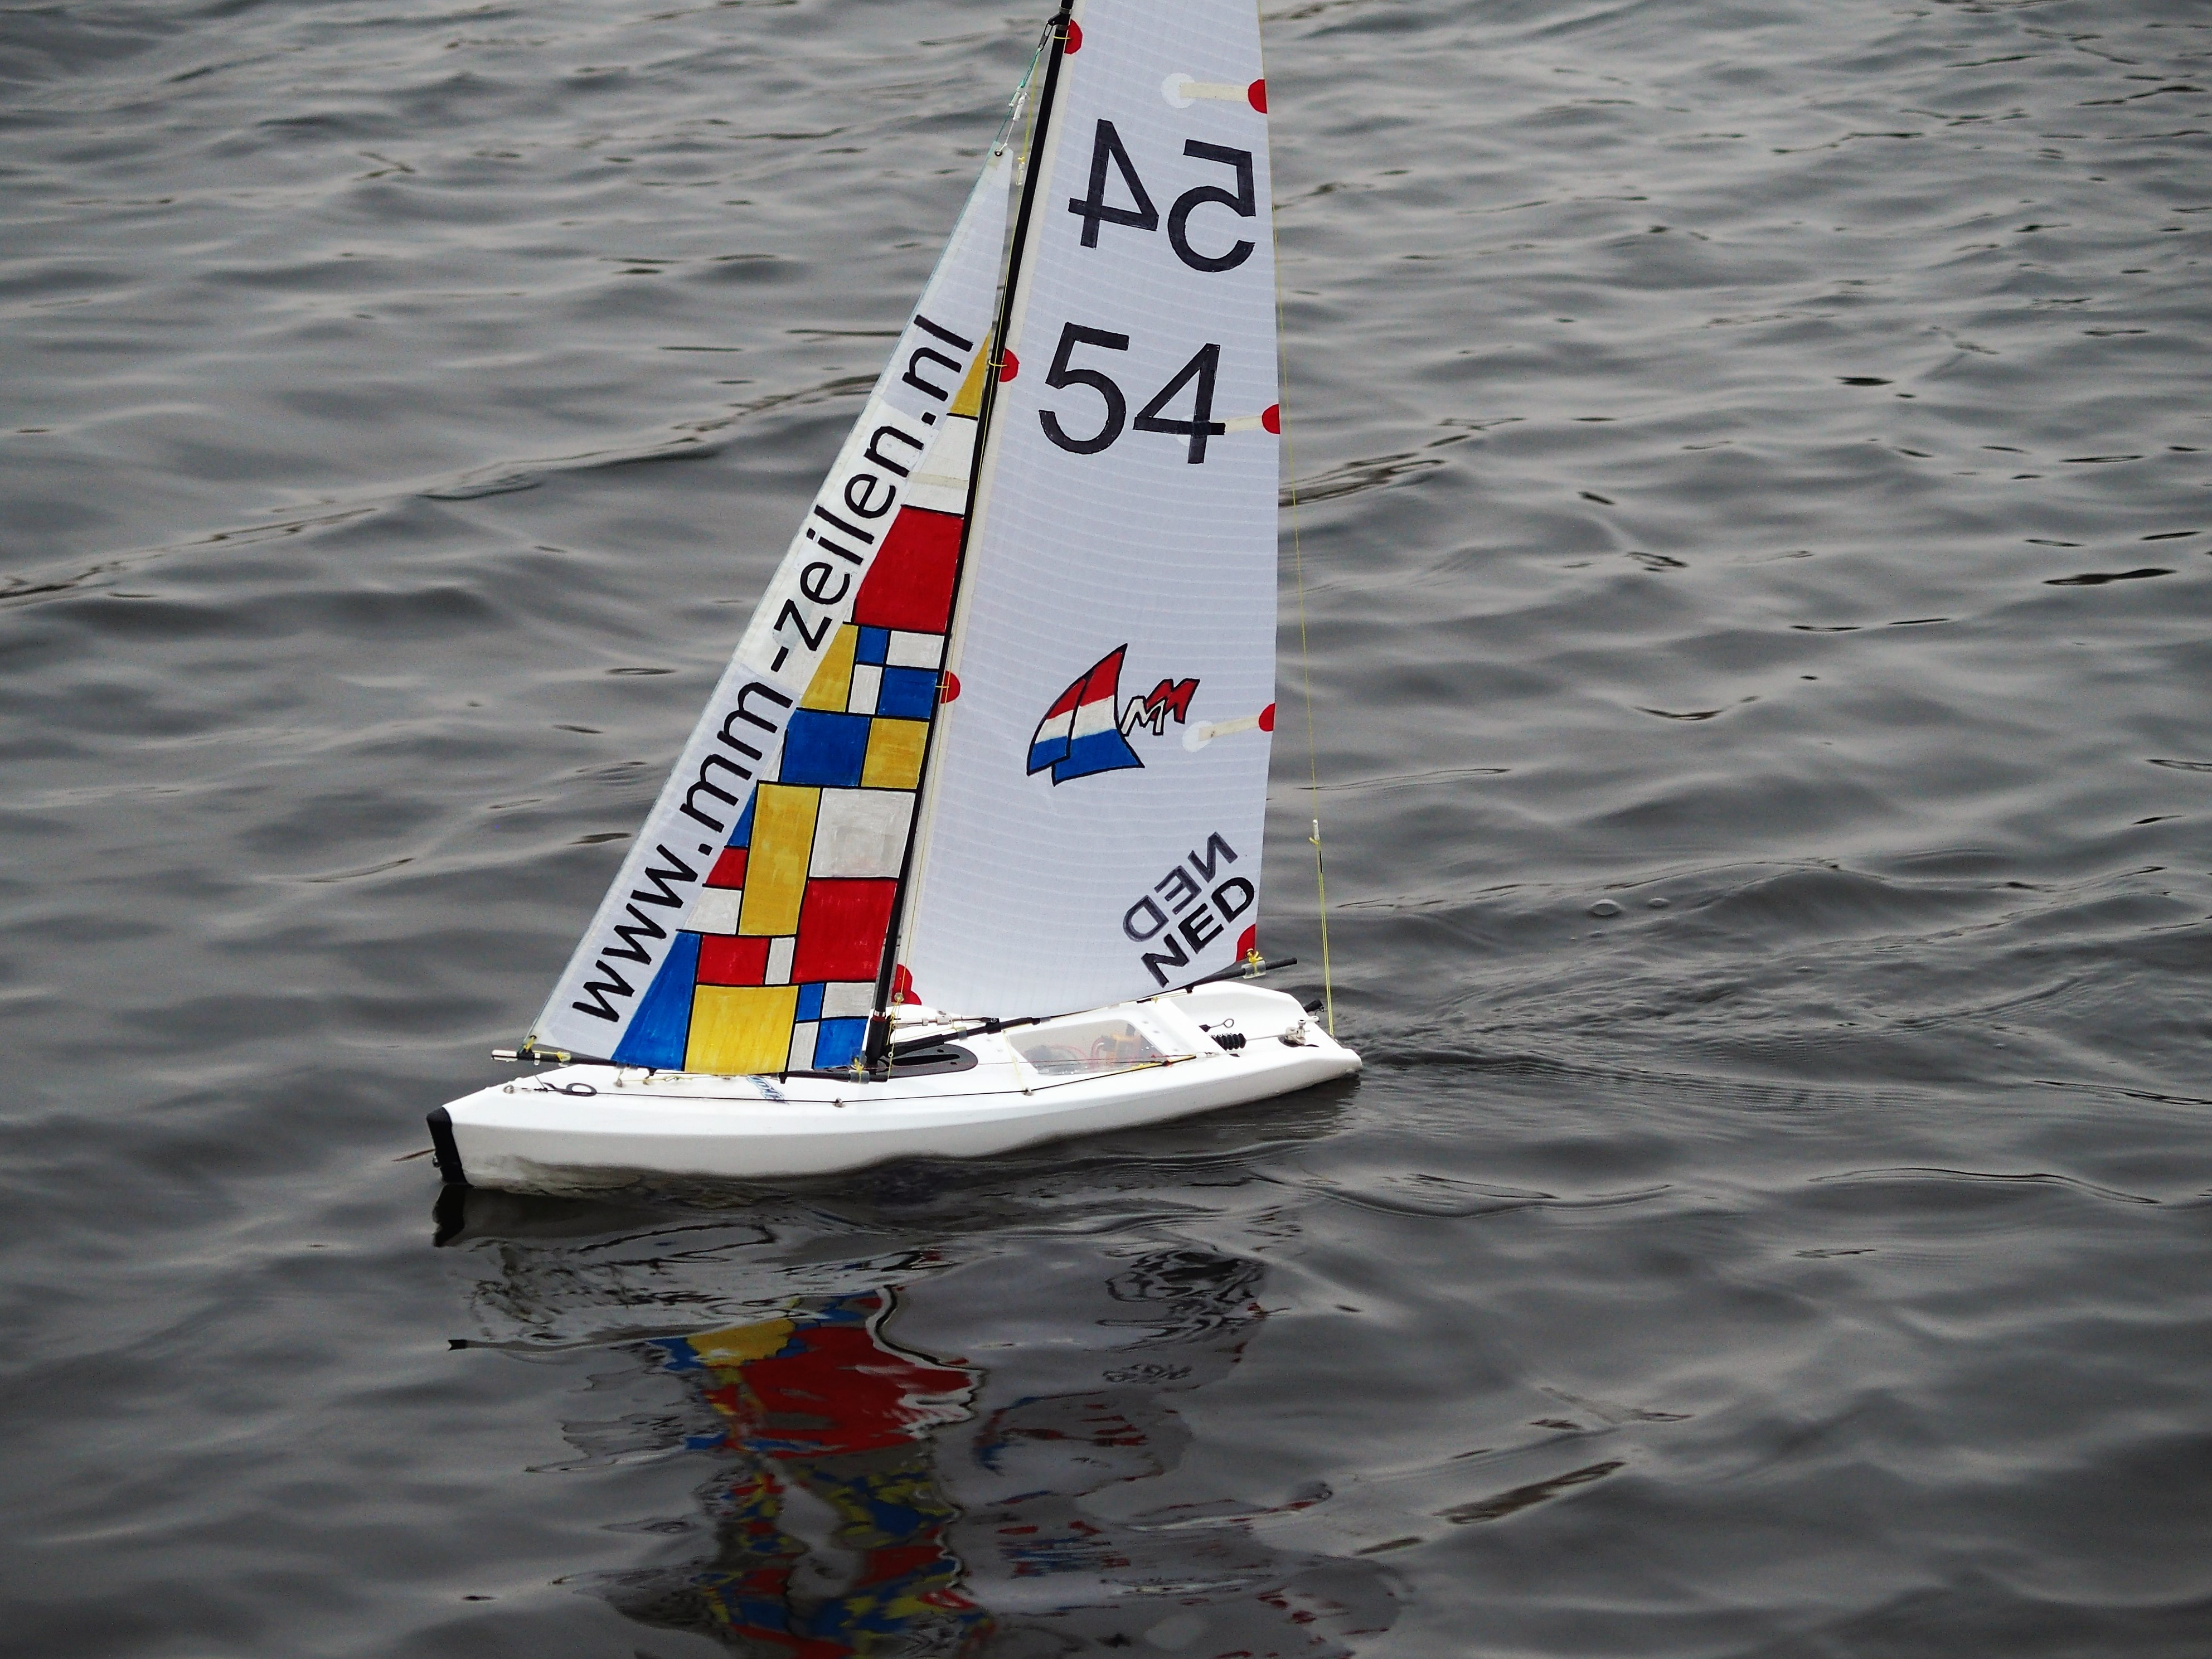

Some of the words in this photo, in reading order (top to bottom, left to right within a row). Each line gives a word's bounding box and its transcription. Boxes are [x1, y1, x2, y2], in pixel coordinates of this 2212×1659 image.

[1038, 322, 1226, 464] 54
[572, 314, 974, 1022] www.mm-zeilen.nl
[1120, 678, 1200, 737] MM
[1143, 877, 1255, 988] NED
